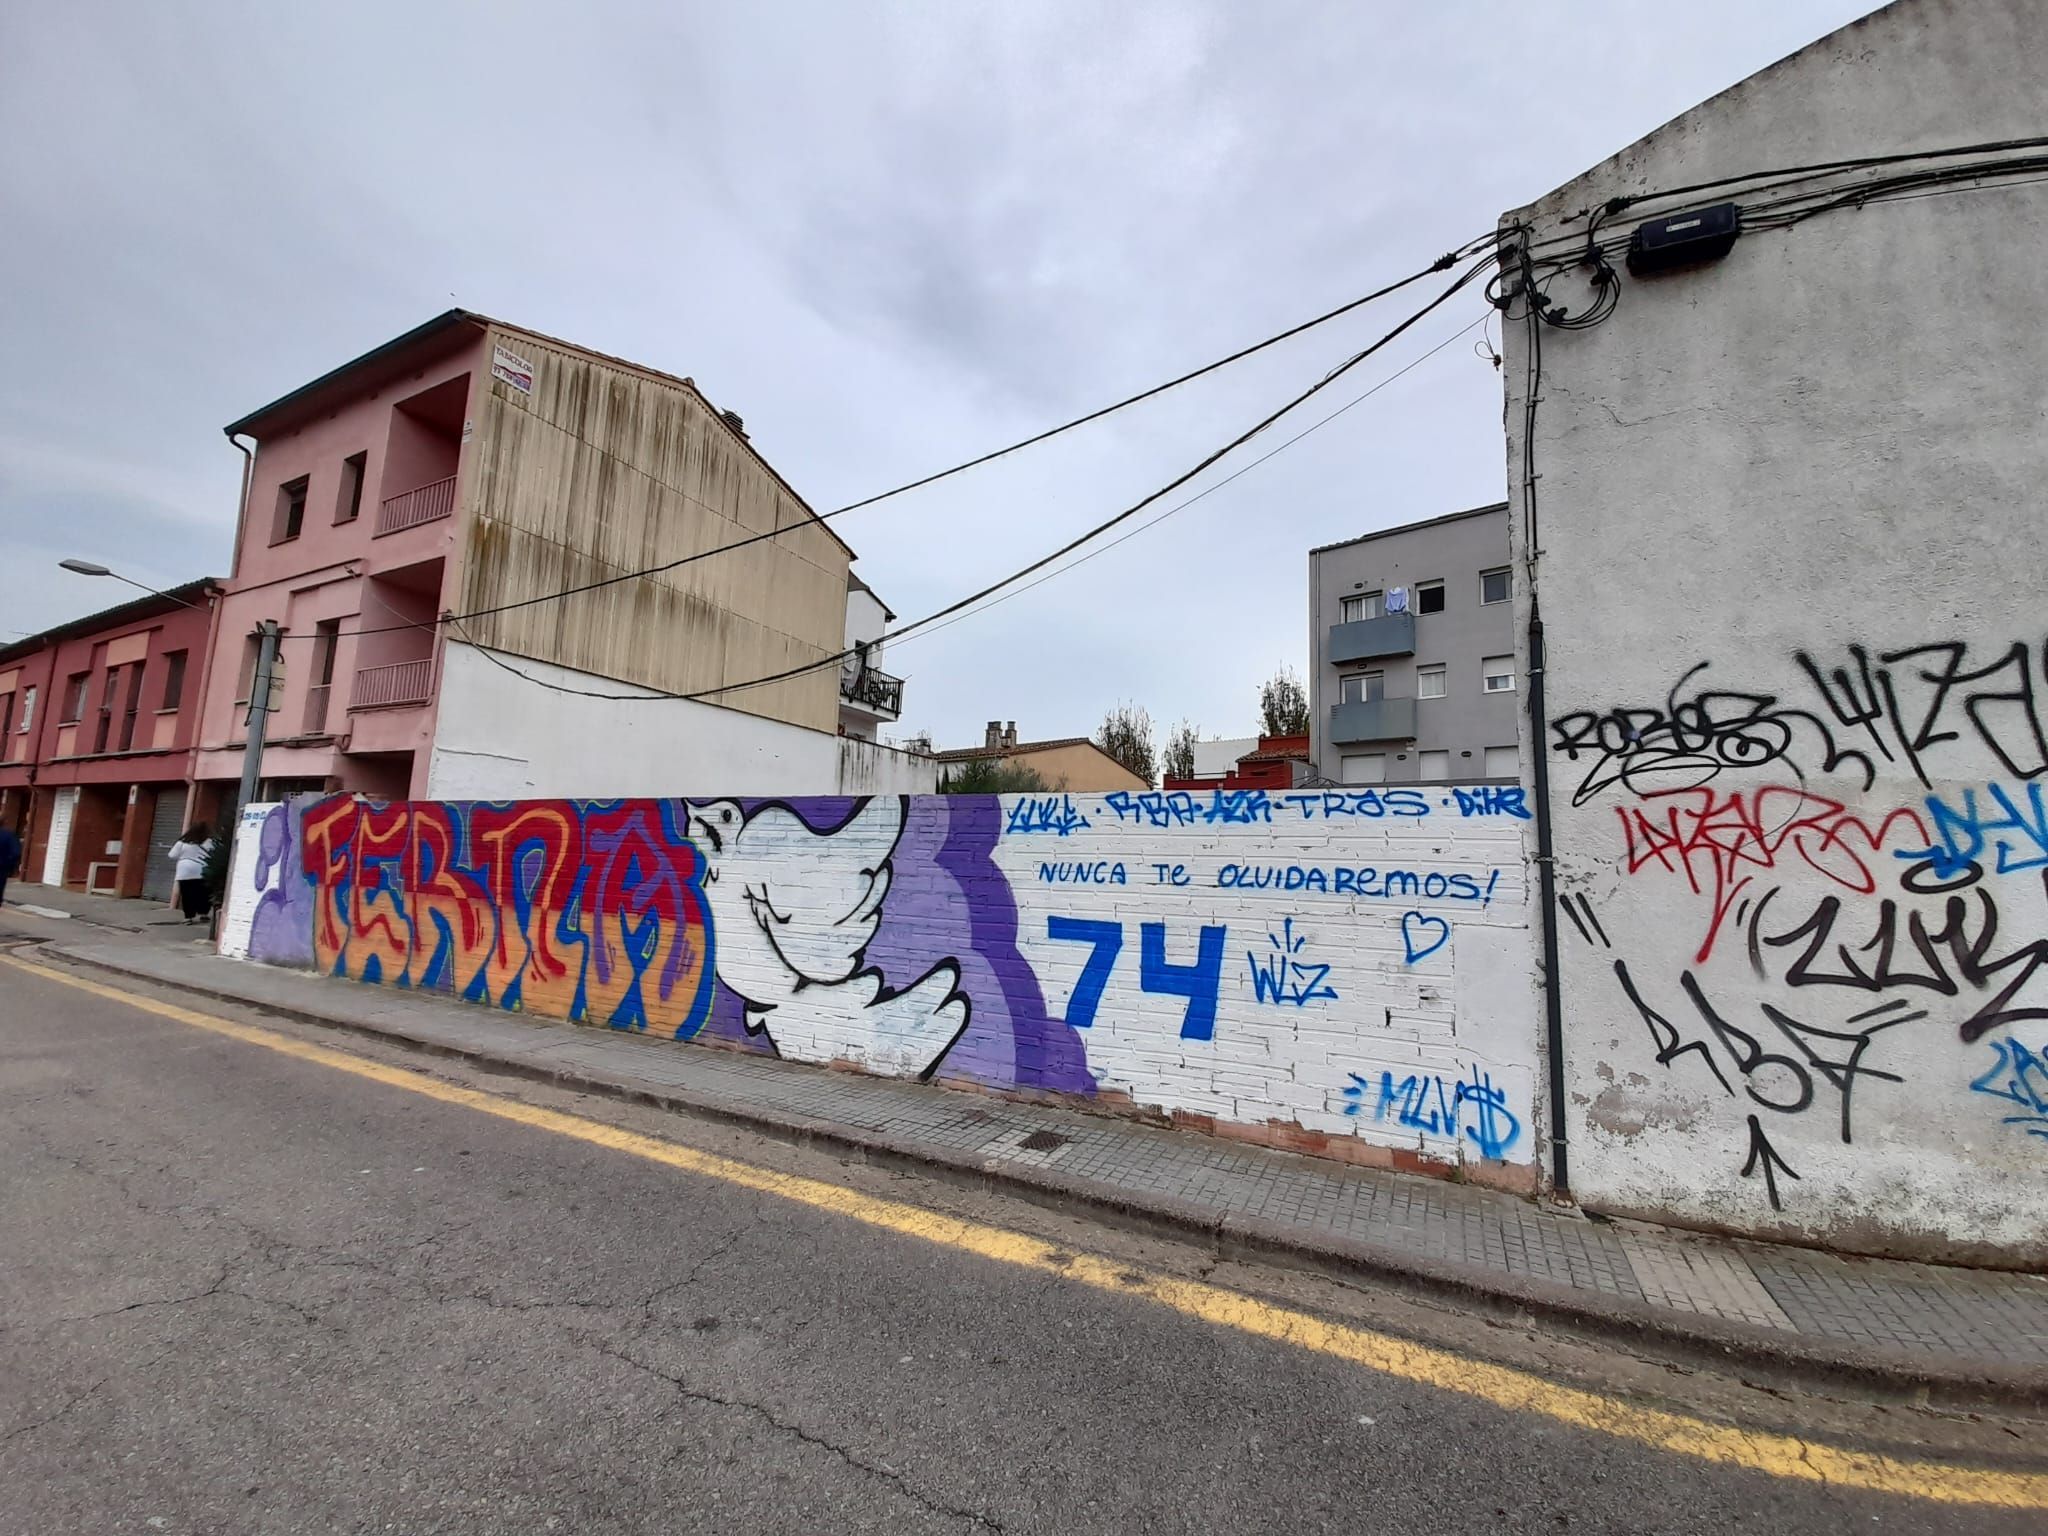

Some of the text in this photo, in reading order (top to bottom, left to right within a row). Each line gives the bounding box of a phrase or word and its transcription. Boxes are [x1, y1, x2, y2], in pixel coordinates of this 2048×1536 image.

[1039, 862, 1126, 885] NUNCA
[1152, 864, 1190, 886] Te
[1047, 916, 1226, 1041] 74
